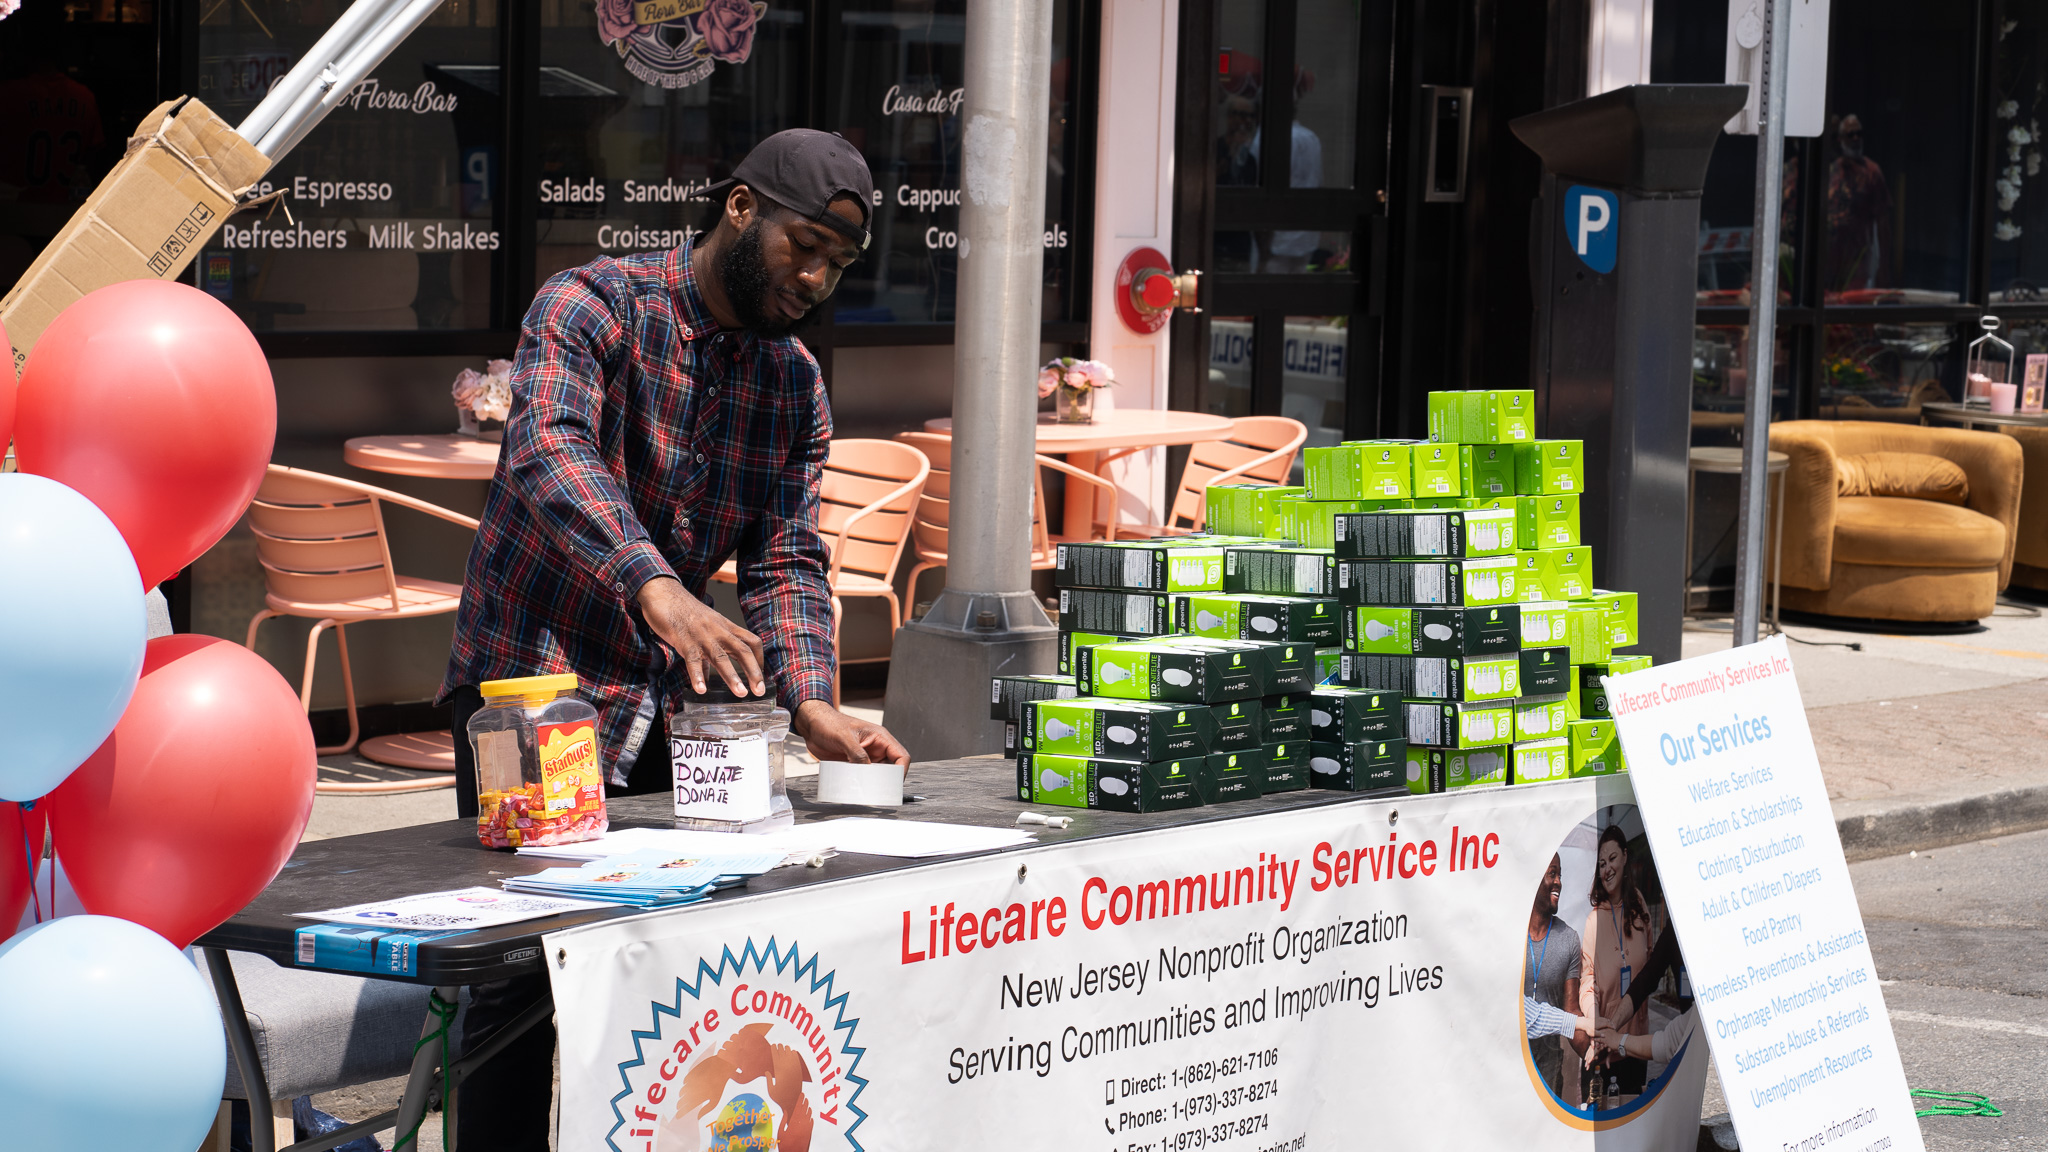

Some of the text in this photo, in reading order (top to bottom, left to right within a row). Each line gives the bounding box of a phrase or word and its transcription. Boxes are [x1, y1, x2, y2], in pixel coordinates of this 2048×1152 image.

[644, 3, 676, 21] Flora
[351, 78, 411, 112] Flora
[412, 81, 458, 114] Bar
[882, 84, 926, 116] Casa
[927, 90, 949, 113] de
[294, 176, 393, 208] Espresso
[540, 177, 606, 203] Salads
[223, 220, 499, 250] Refreshers Milk Shakes
[1043, 223, 1068, 248] els
[1577, 194, 1611, 256] P
[1616, 655, 1790, 716] Lifecare Community Services Inc
[544, 740, 593, 777] Starburst
[671, 739, 729, 760] DONATE
[1660, 713, 1772, 766] Our Services
[675, 762, 745, 785] DONATE
[1688, 766, 1773, 804] Welfare Services
[676, 784, 729, 805] DONATE
[1678, 794, 1803, 847] Education & Scholarships
[1698, 833, 1805, 881] Clothing Disturbution
[901, 825, 1500, 965] Lifecare Community Service Inc
[1702, 867, 1822, 921] Adult & Children Diapers
[1742, 913, 1802, 947] Food Pantry
[391, 942, 399, 972] TABLE
[507, 949, 537, 961] LIFETIME
[1000, 910, 1408, 1010] New Jersey Nonprofit Organization
[1697, 928, 1864, 1005] Homeless Preventions & Assistants
[1716, 967, 1867, 1039] Orphanage Mentorship Services
[948, 963, 1443, 1084] Serving Communities and Improving Lives
[1735, 1003, 1869, 1074] Substance Abuse & Referrals
[630, 983, 842, 1152] ifecare Community
[1121, 1048, 1278, 1098] Direct: 1-(862)-621-7106
[1750, 1044, 1873, 1108] Unemployment Resources
[705, 1108, 776, 1137] Together
[1119, 1079, 1278, 1132] Phone: 1-(973)-337-8274
[729, 1135, 781, 1152] Prosper
[1162, 1113, 1268, 1152] 1-(973)-337-8274
[1783, 1142, 1799, 1152] For
[1801, 1132, 1825, 1152] more
